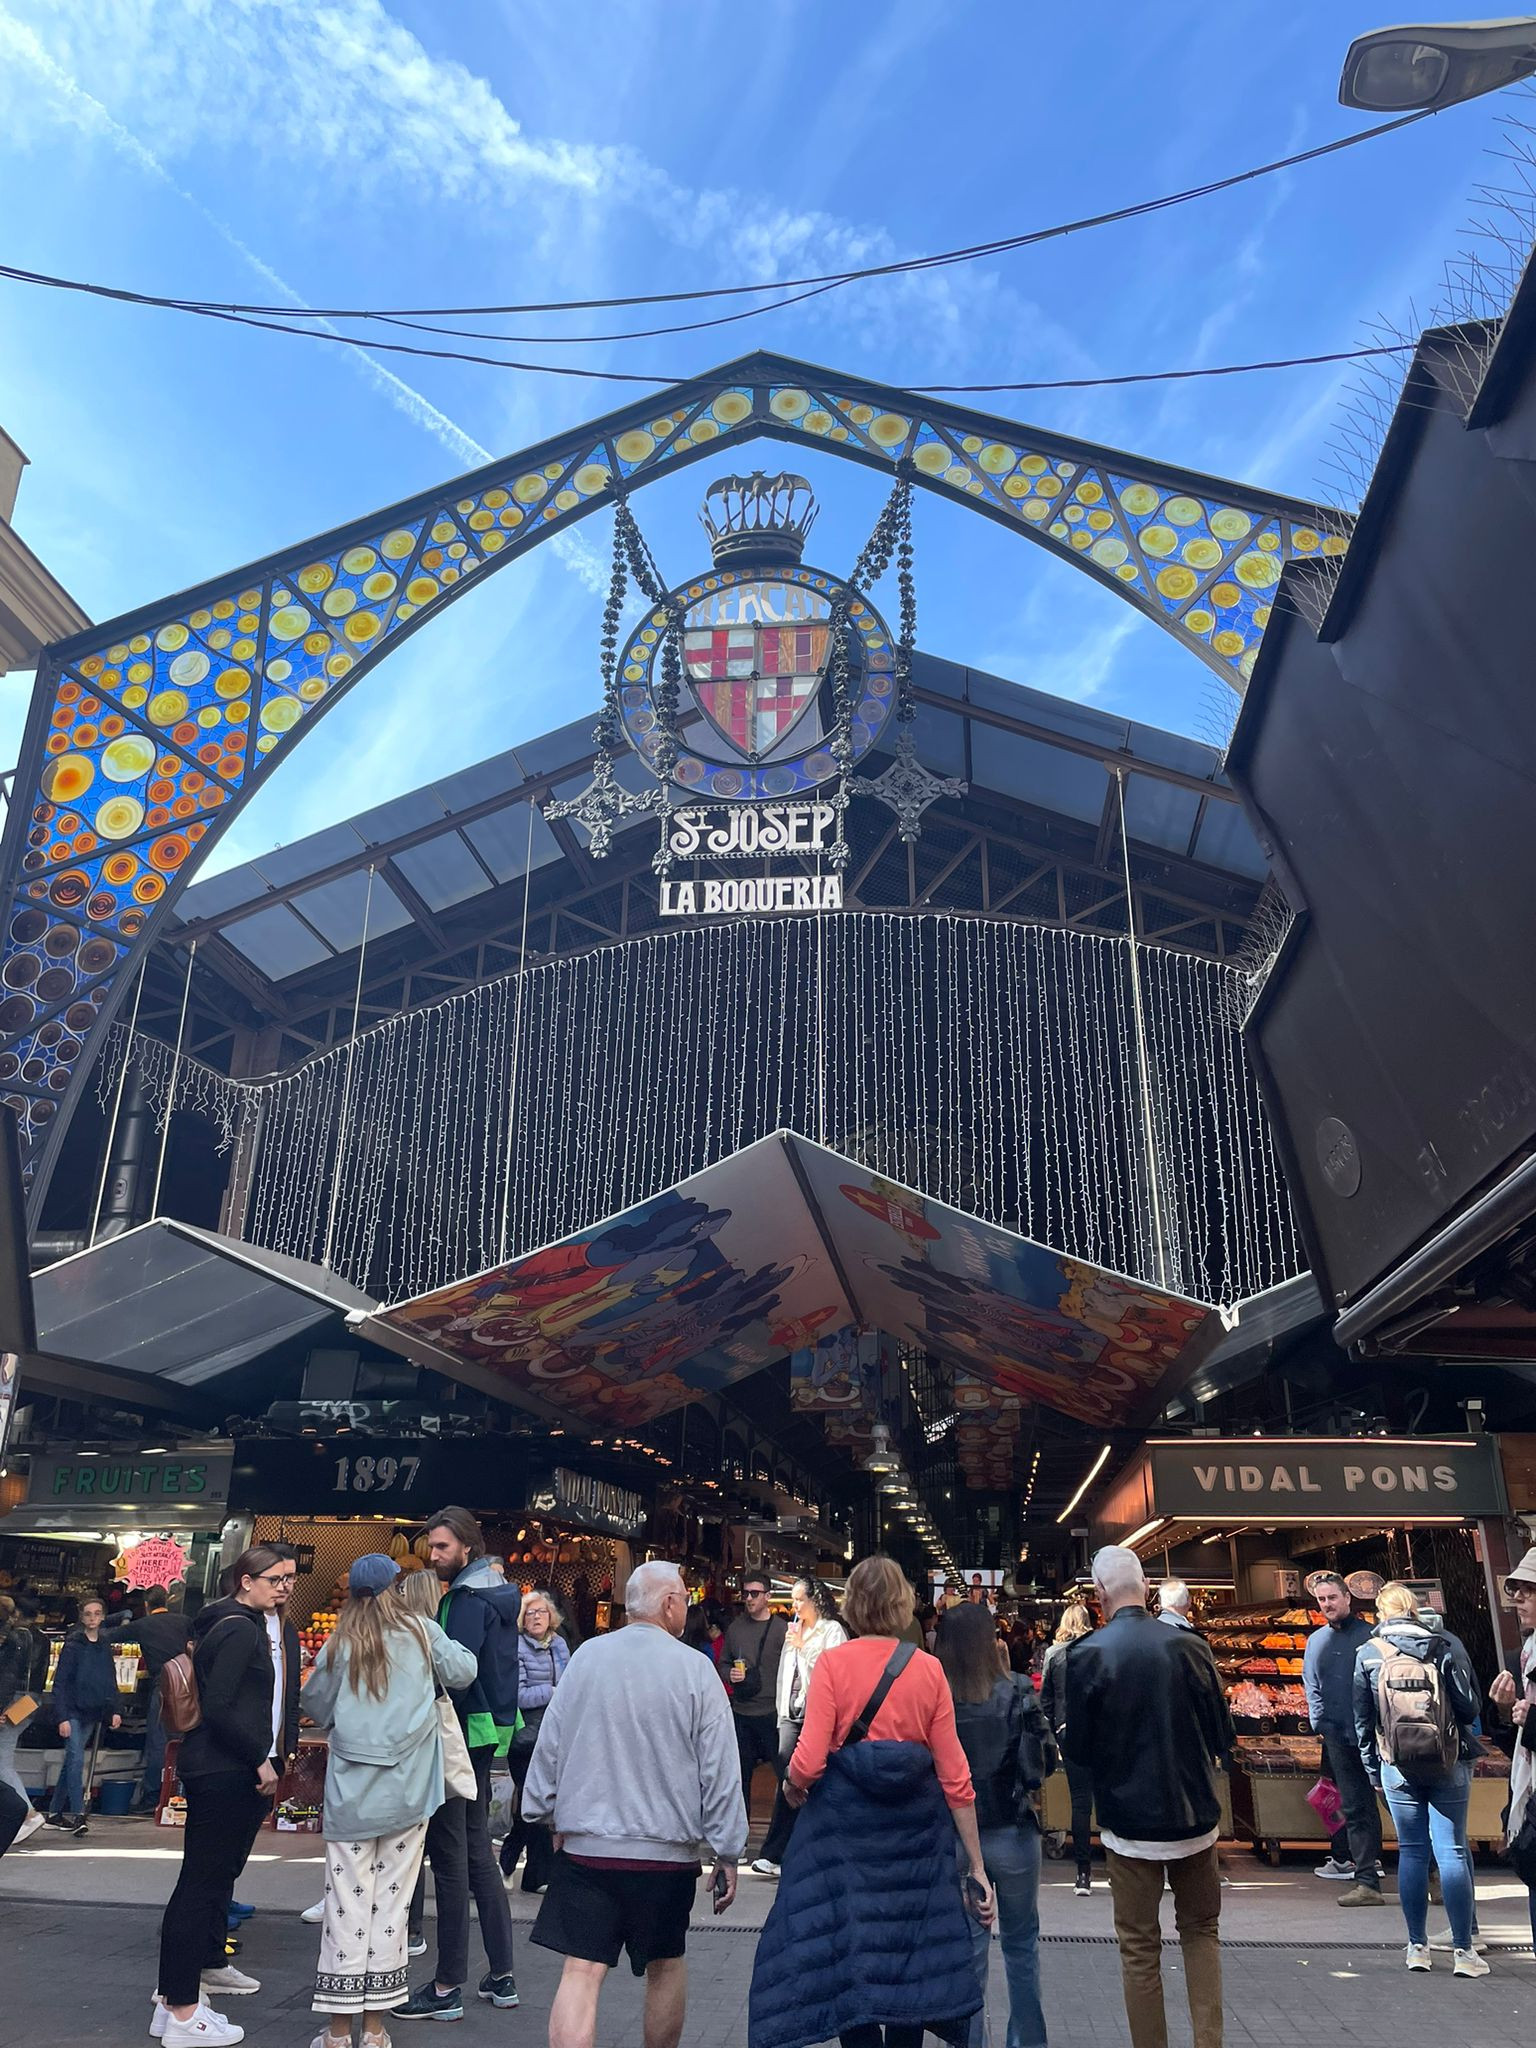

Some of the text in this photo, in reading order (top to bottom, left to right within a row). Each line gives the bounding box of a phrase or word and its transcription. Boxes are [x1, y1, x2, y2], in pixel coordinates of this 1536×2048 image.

[690, 583, 826, 626] MERCAT
[707, 804, 835, 853] JOSEP
[660, 875, 842, 914] LA BOQUERIA
[52, 1464, 208, 1496] FRUITES
[331, 1455, 422, 1492] 1897
[1192, 1465, 1459, 1492] VIDAL PONS
